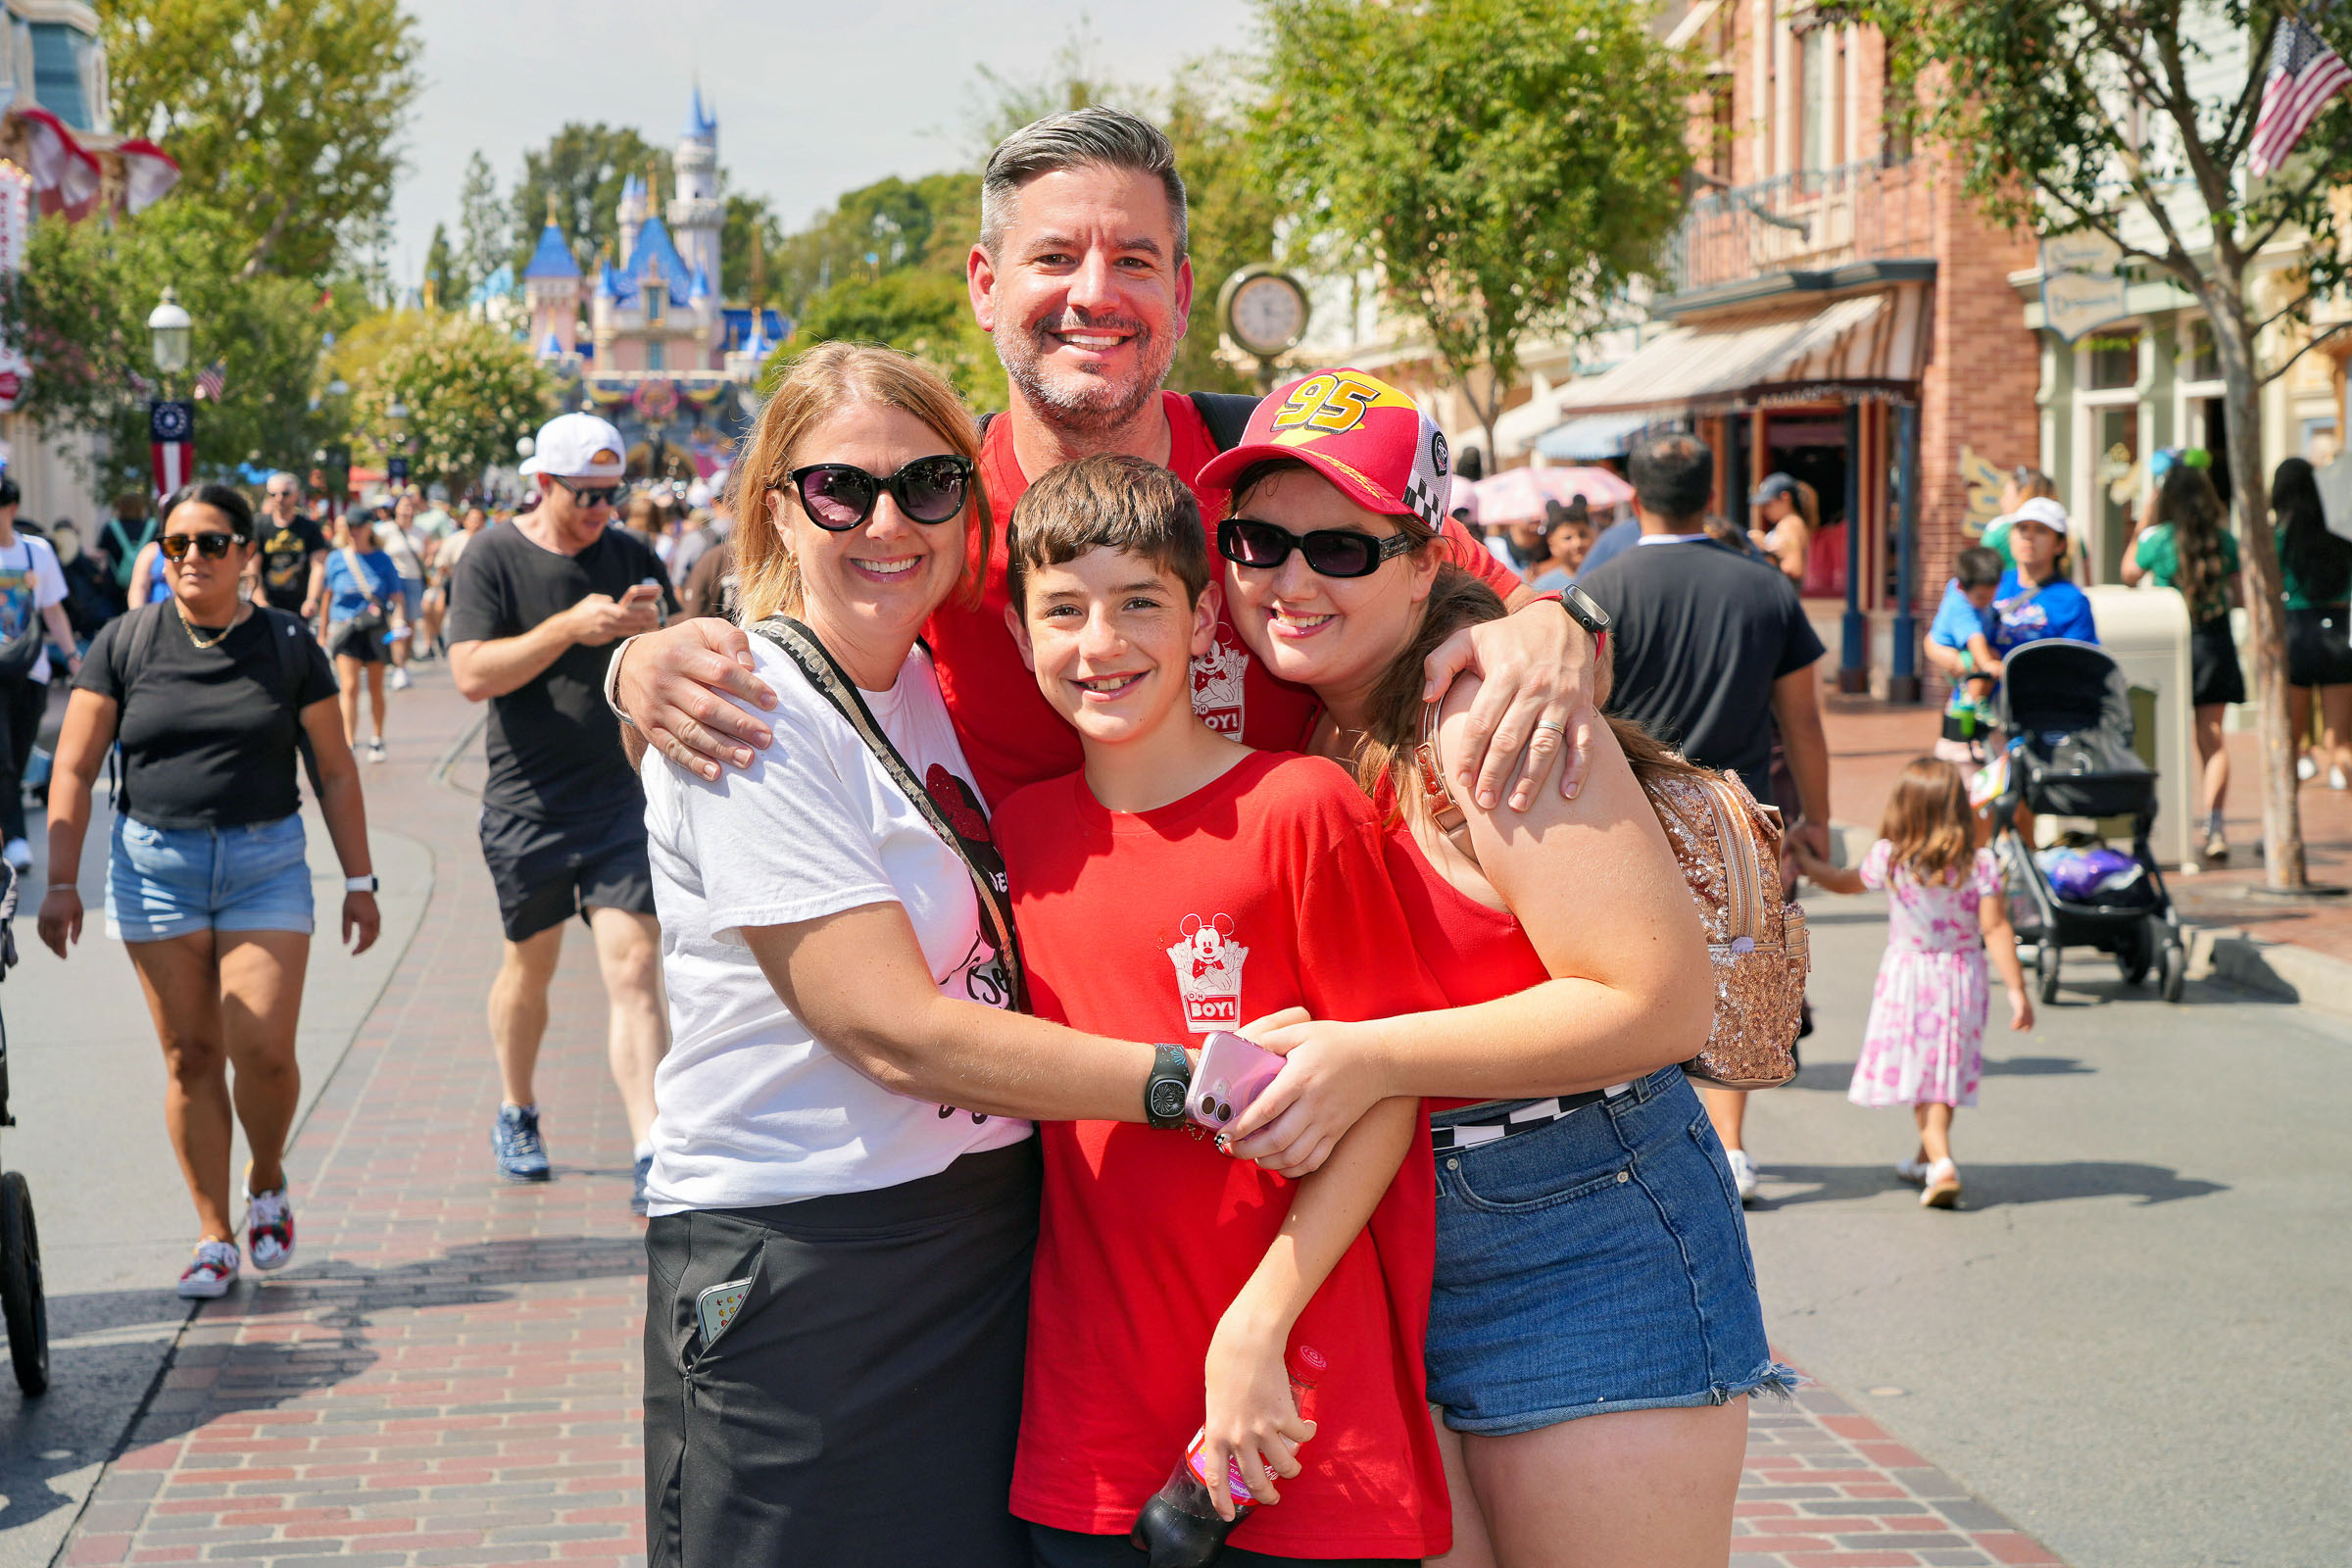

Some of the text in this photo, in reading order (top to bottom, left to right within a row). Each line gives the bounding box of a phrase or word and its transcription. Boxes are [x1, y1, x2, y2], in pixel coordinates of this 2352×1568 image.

[1270, 373, 1381, 435] 95
[1204, 712, 1239, 730] OY!
[1190, 1001, 1235, 1017] BOY!
